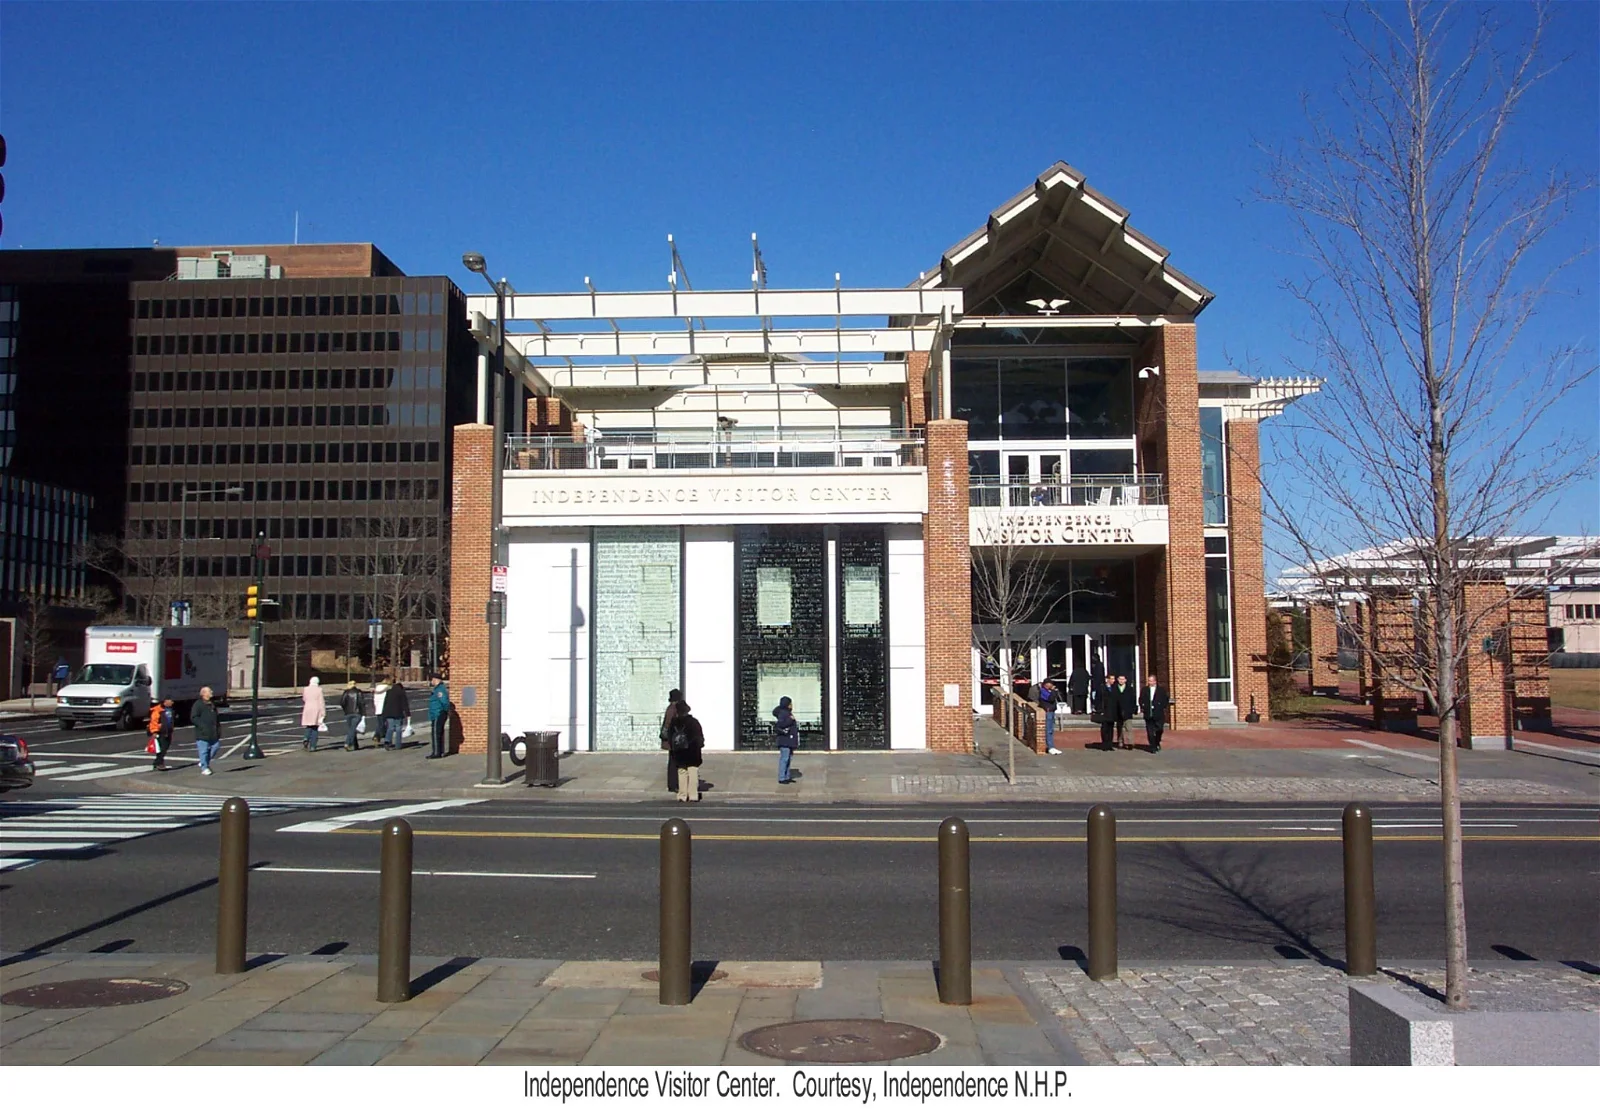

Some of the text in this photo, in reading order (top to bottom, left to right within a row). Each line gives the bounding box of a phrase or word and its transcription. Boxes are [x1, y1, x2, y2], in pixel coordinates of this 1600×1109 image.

[532, 487, 892, 504] INDEPENDENCE VISITOR CENTER
[1000, 515, 1111, 527] INDEPENDENCE
[977, 526, 1135, 544] VISITOR CENTER
